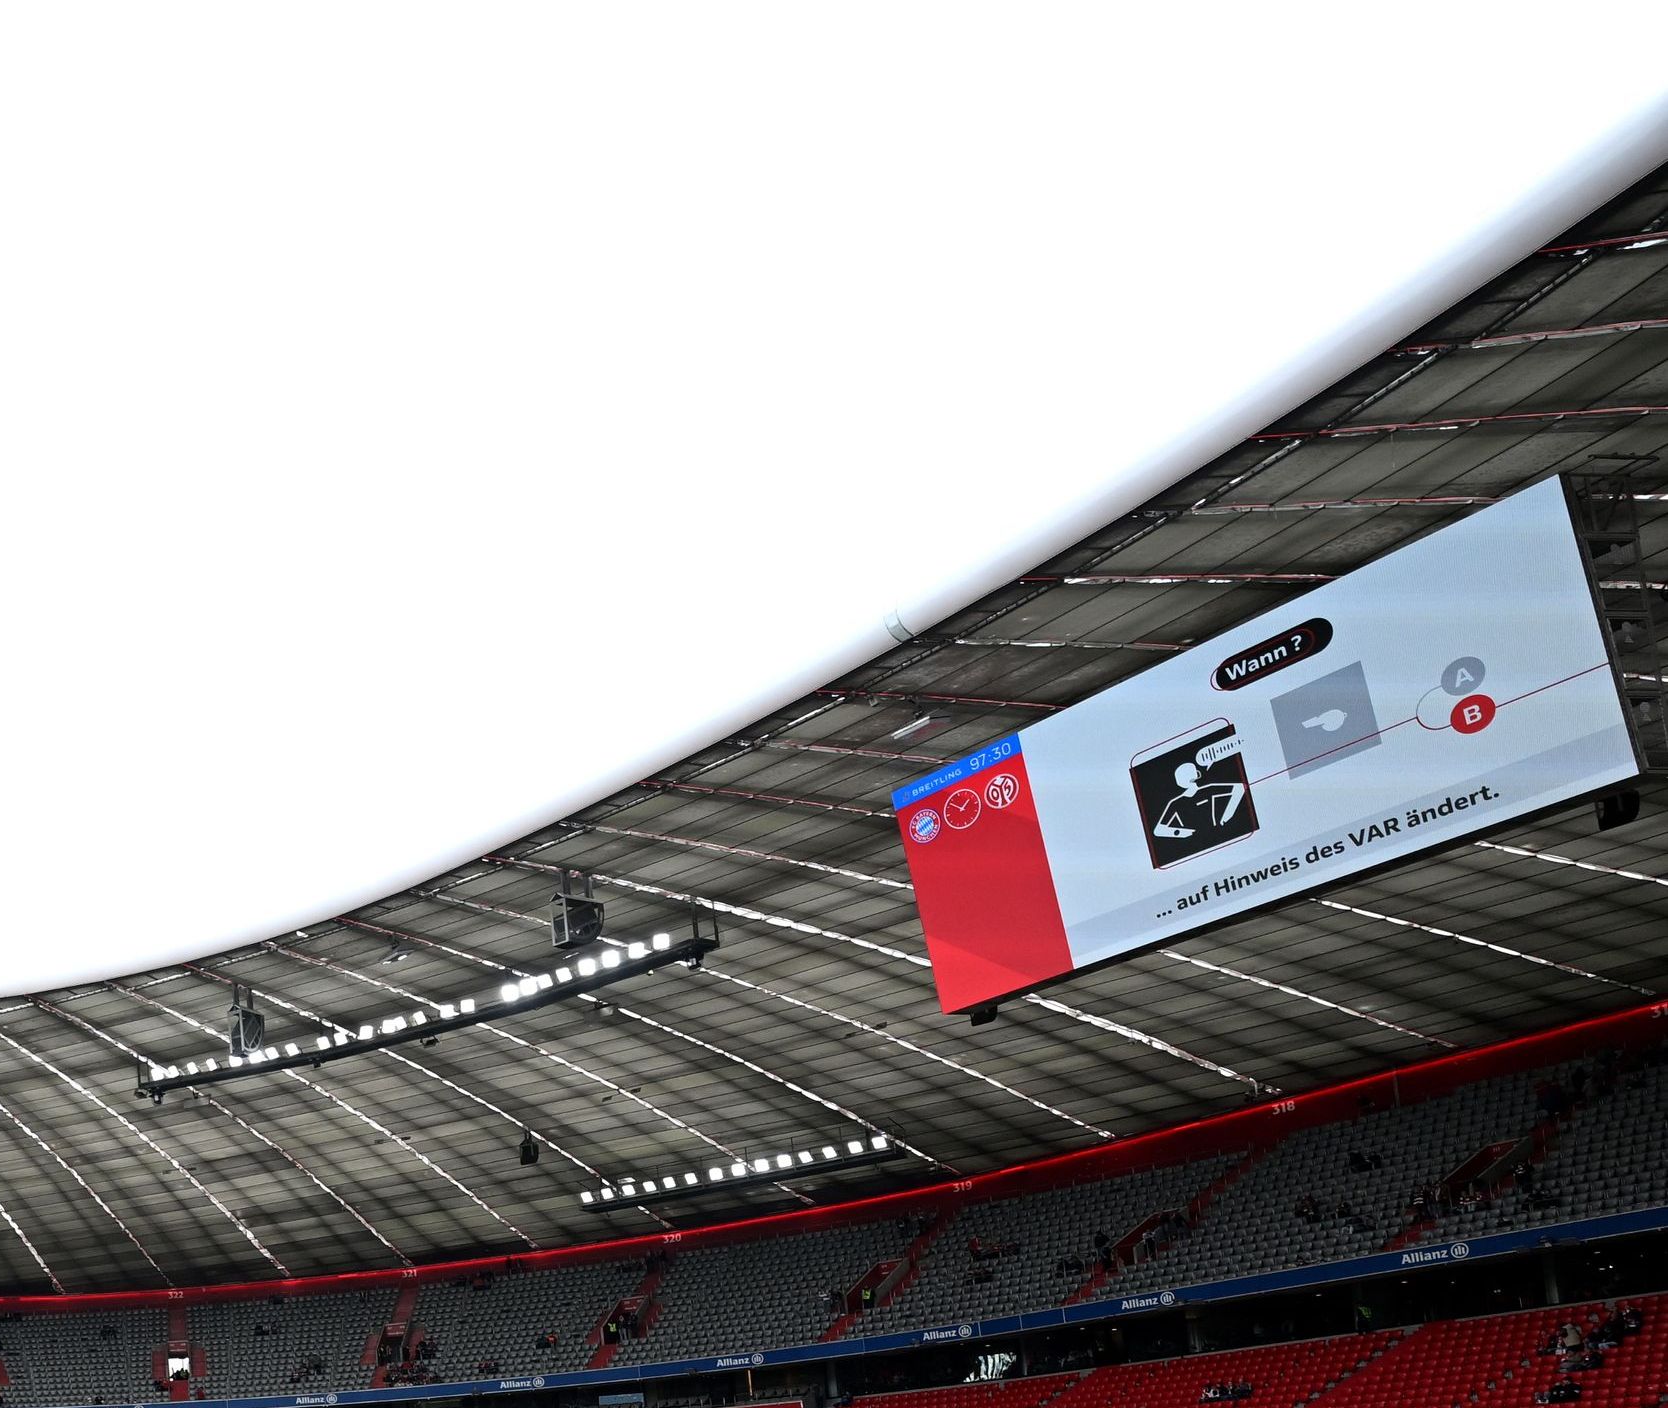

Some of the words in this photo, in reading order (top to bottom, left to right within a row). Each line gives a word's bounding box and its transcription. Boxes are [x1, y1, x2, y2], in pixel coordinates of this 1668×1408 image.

[1225, 646, 1288, 681] Wann
[1454, 668, 1474, 687] A
[1463, 703, 1482, 725] B
[969, 742, 1012, 770] 97:30
[912, 769, 963, 797] BREITLING
[1176, 885, 1210, 911] auf
[1214, 854, 1300, 898] Hinweis
[1305, 836, 1346, 866] des
[1348, 819, 1401, 848] VAR
[1406, 786, 1501, 830] ändert.
[1401, 1250, 1449, 1266] Allianz
[1121, 1296, 1159, 1310] Allianz
